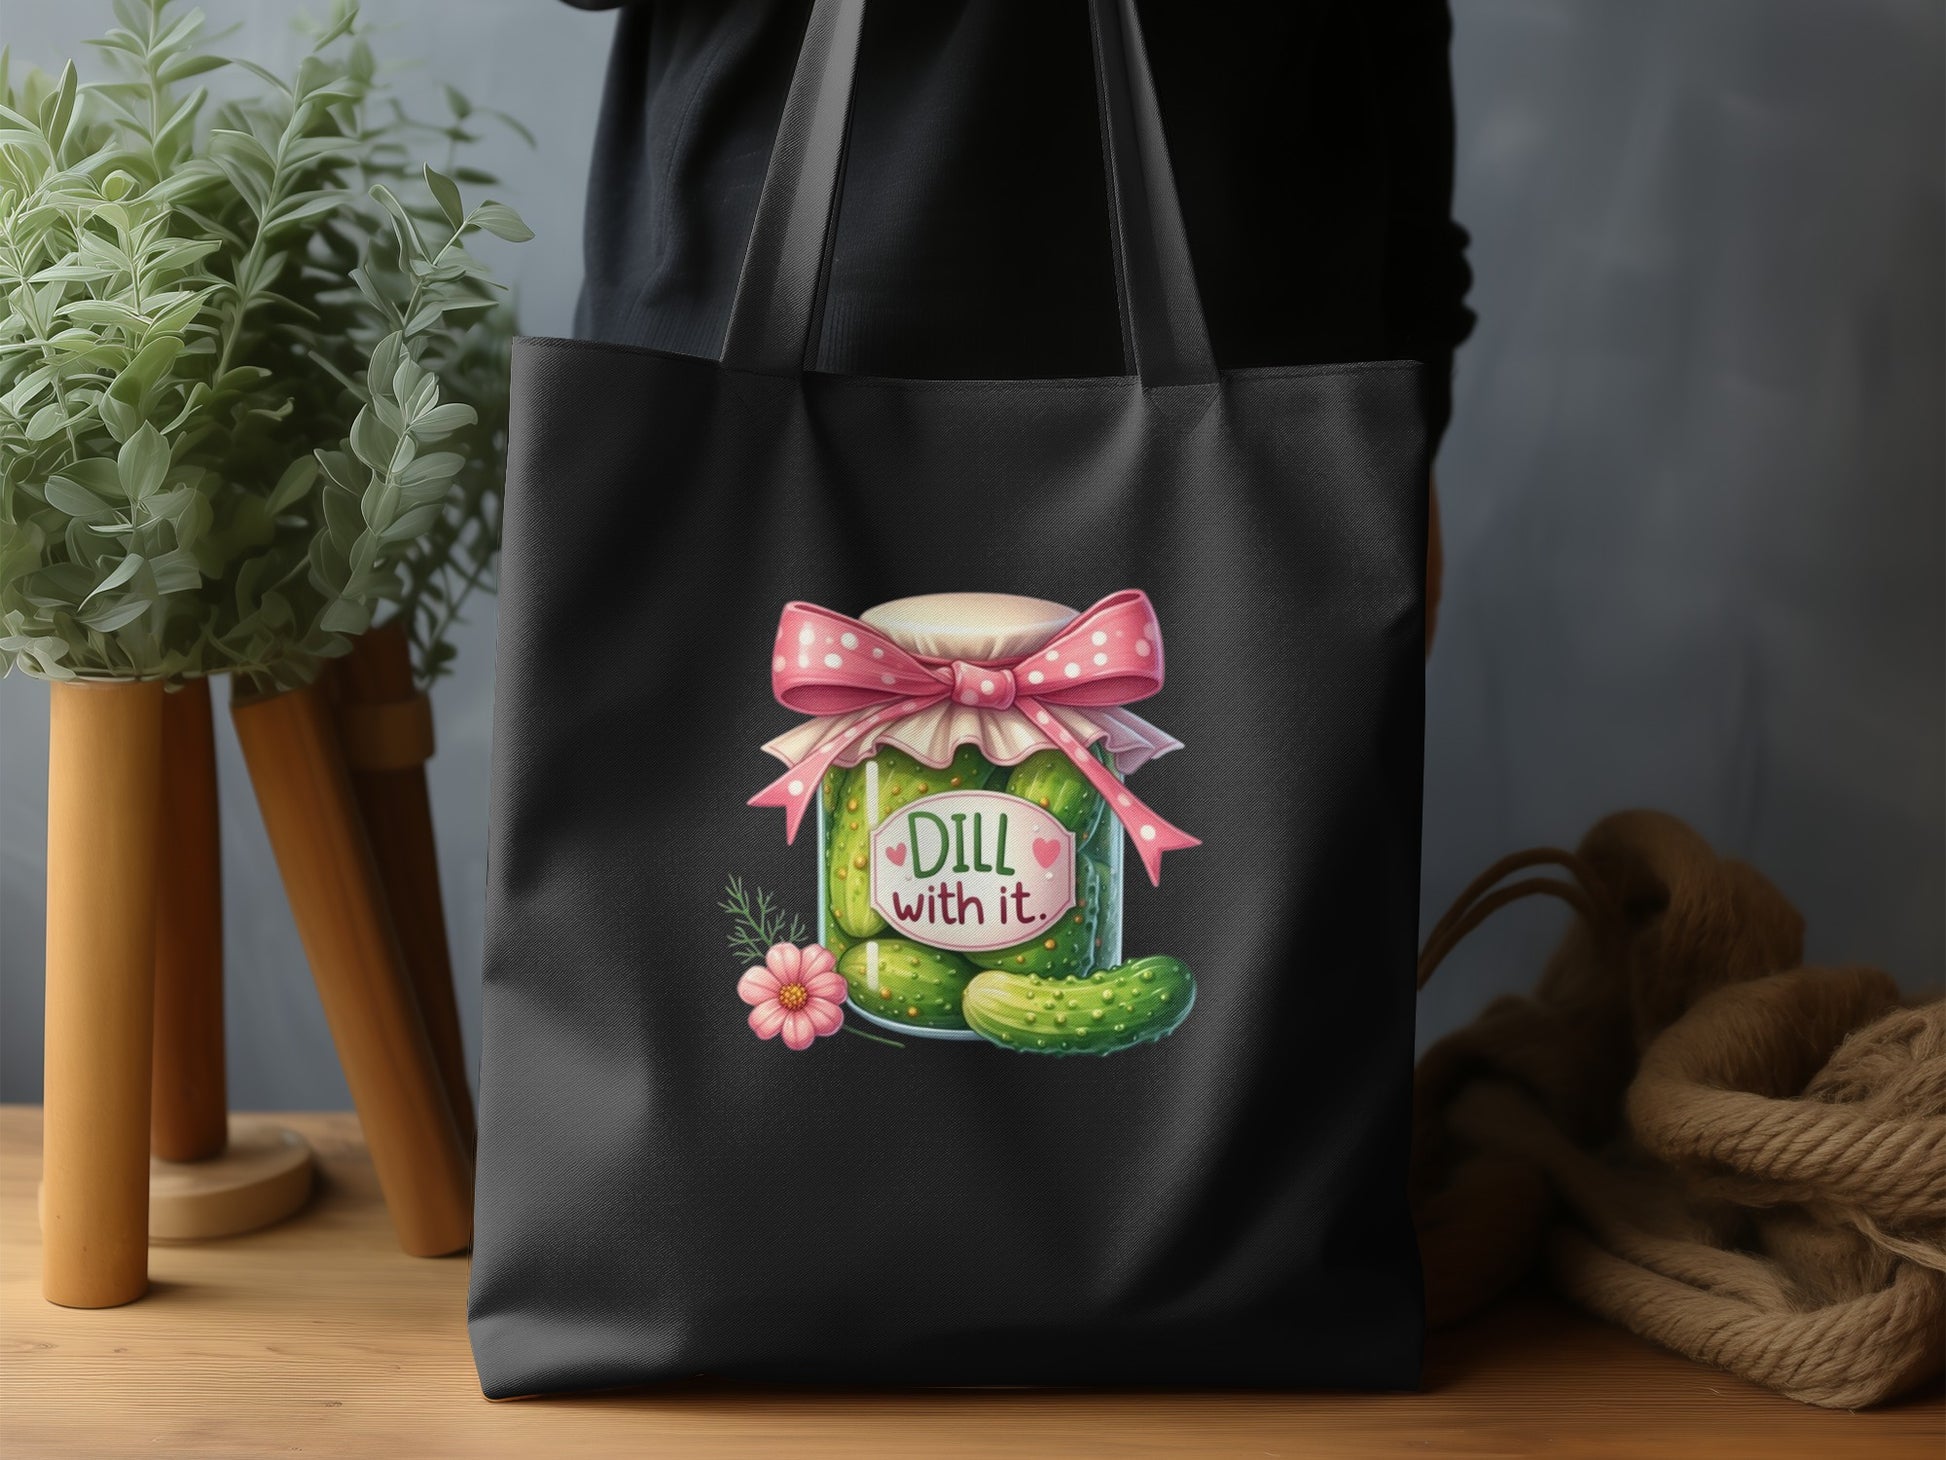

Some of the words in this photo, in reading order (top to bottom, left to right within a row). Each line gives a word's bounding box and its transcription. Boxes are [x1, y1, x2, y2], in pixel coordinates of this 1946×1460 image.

[908, 811, 1015, 879] DILL
[893, 881, 984, 925] with
[1000, 881, 1047, 924] it.
